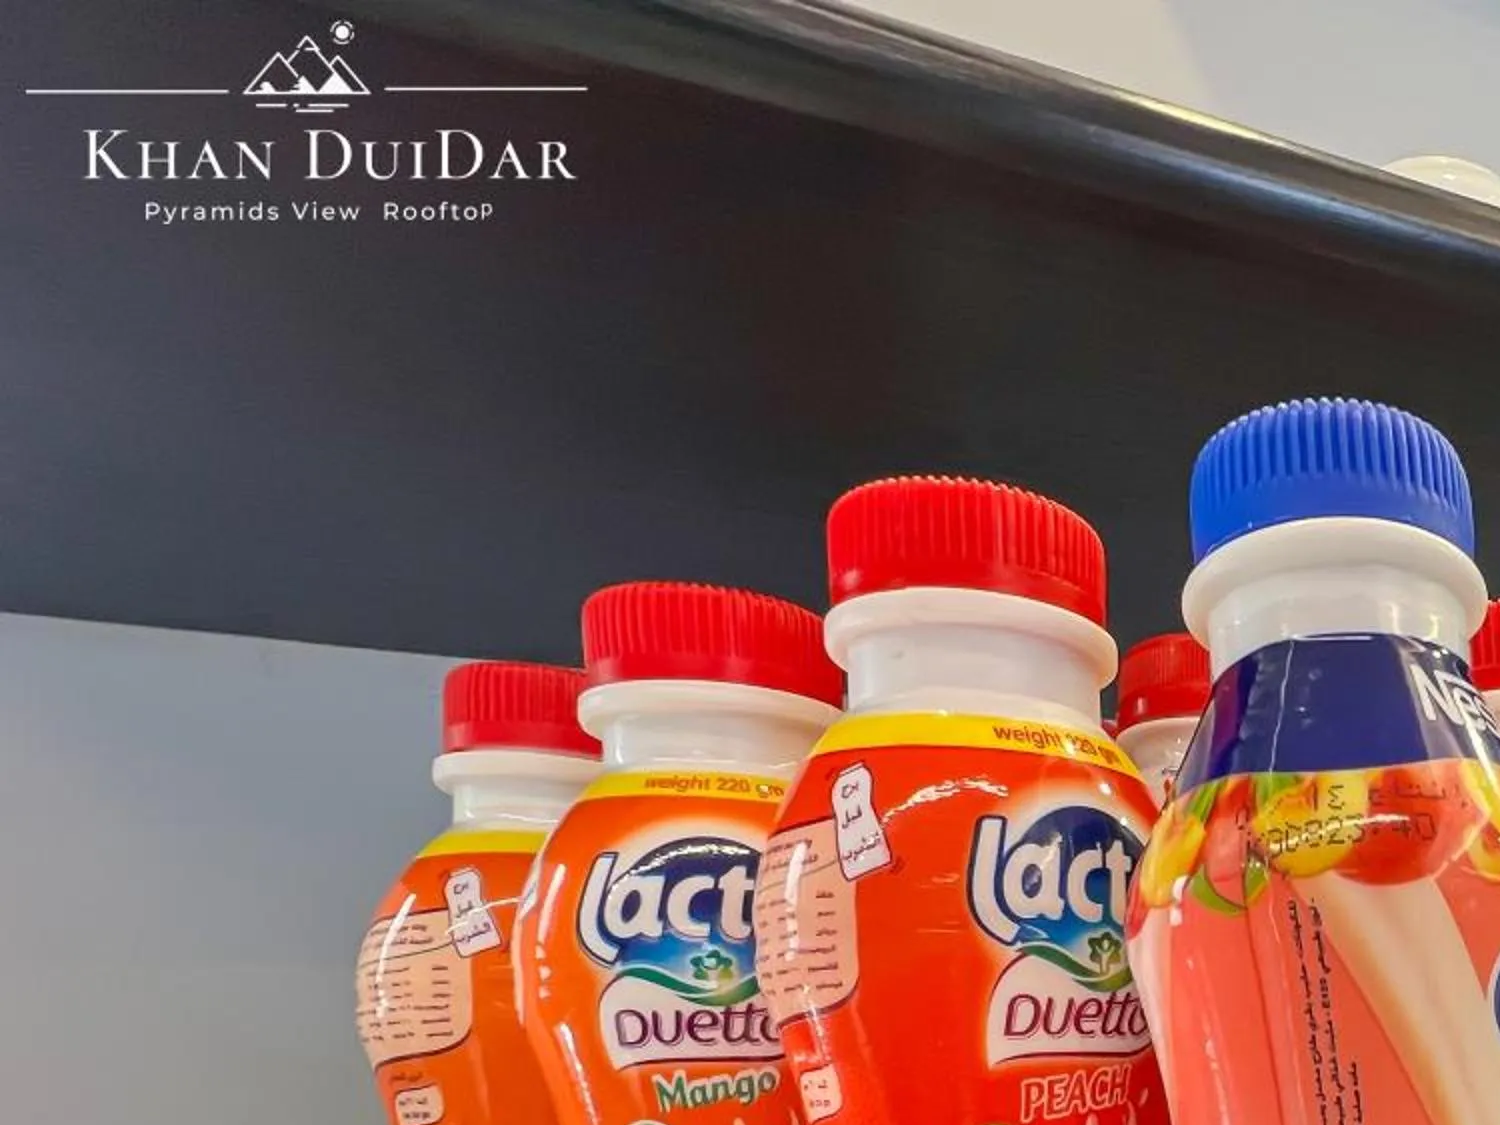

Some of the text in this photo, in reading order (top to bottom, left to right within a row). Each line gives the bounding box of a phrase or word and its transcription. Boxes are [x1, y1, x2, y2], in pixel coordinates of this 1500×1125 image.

[992, 726, 1061, 749] weight
[644, 774, 710, 793] weight
[716, 777, 751, 793] 220
[656, 1068, 777, 1110] Mango
[1021, 1067, 1130, 1122] PEACH
